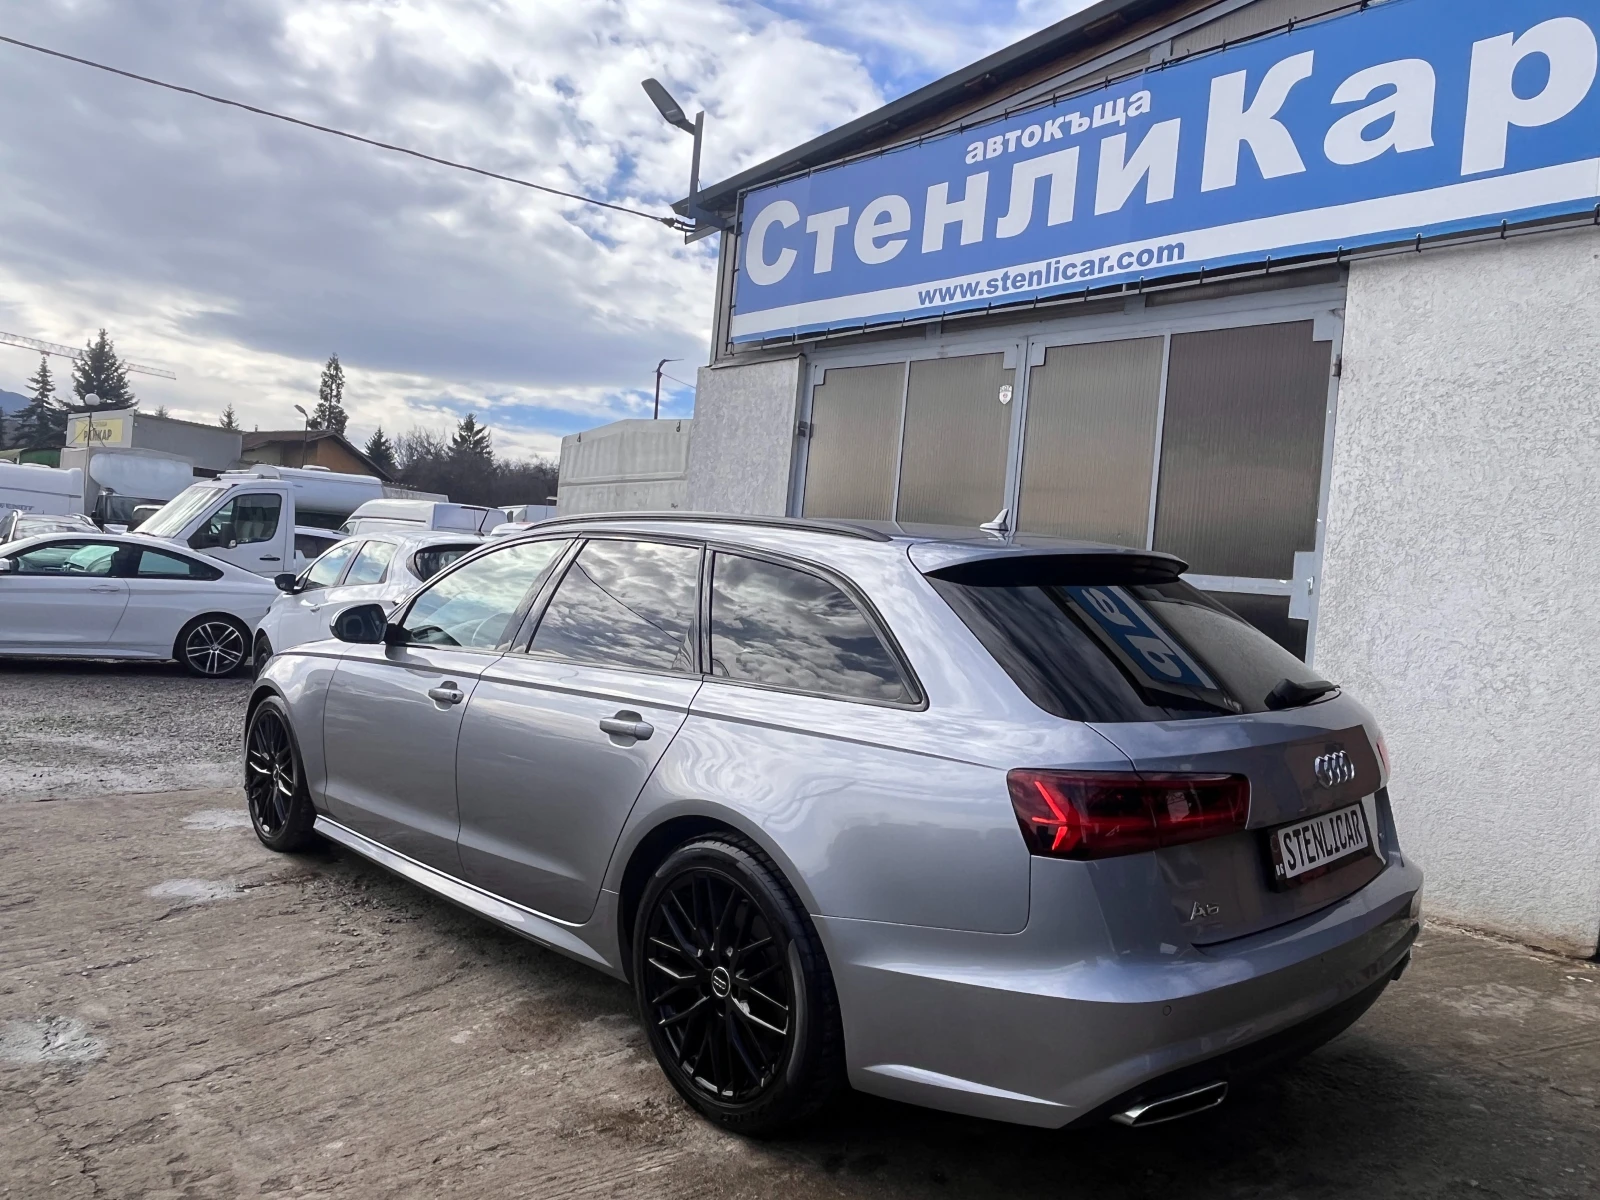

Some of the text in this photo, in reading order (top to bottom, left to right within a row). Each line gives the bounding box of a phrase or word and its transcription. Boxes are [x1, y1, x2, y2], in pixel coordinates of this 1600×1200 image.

[745, 17, 1598, 286] СтенлиКар
[965, 90, 1151, 165] автокъща
[918, 241, 1185, 306] www.stenlicar.com
[1283, 809, 1363, 871] STENLICAR
